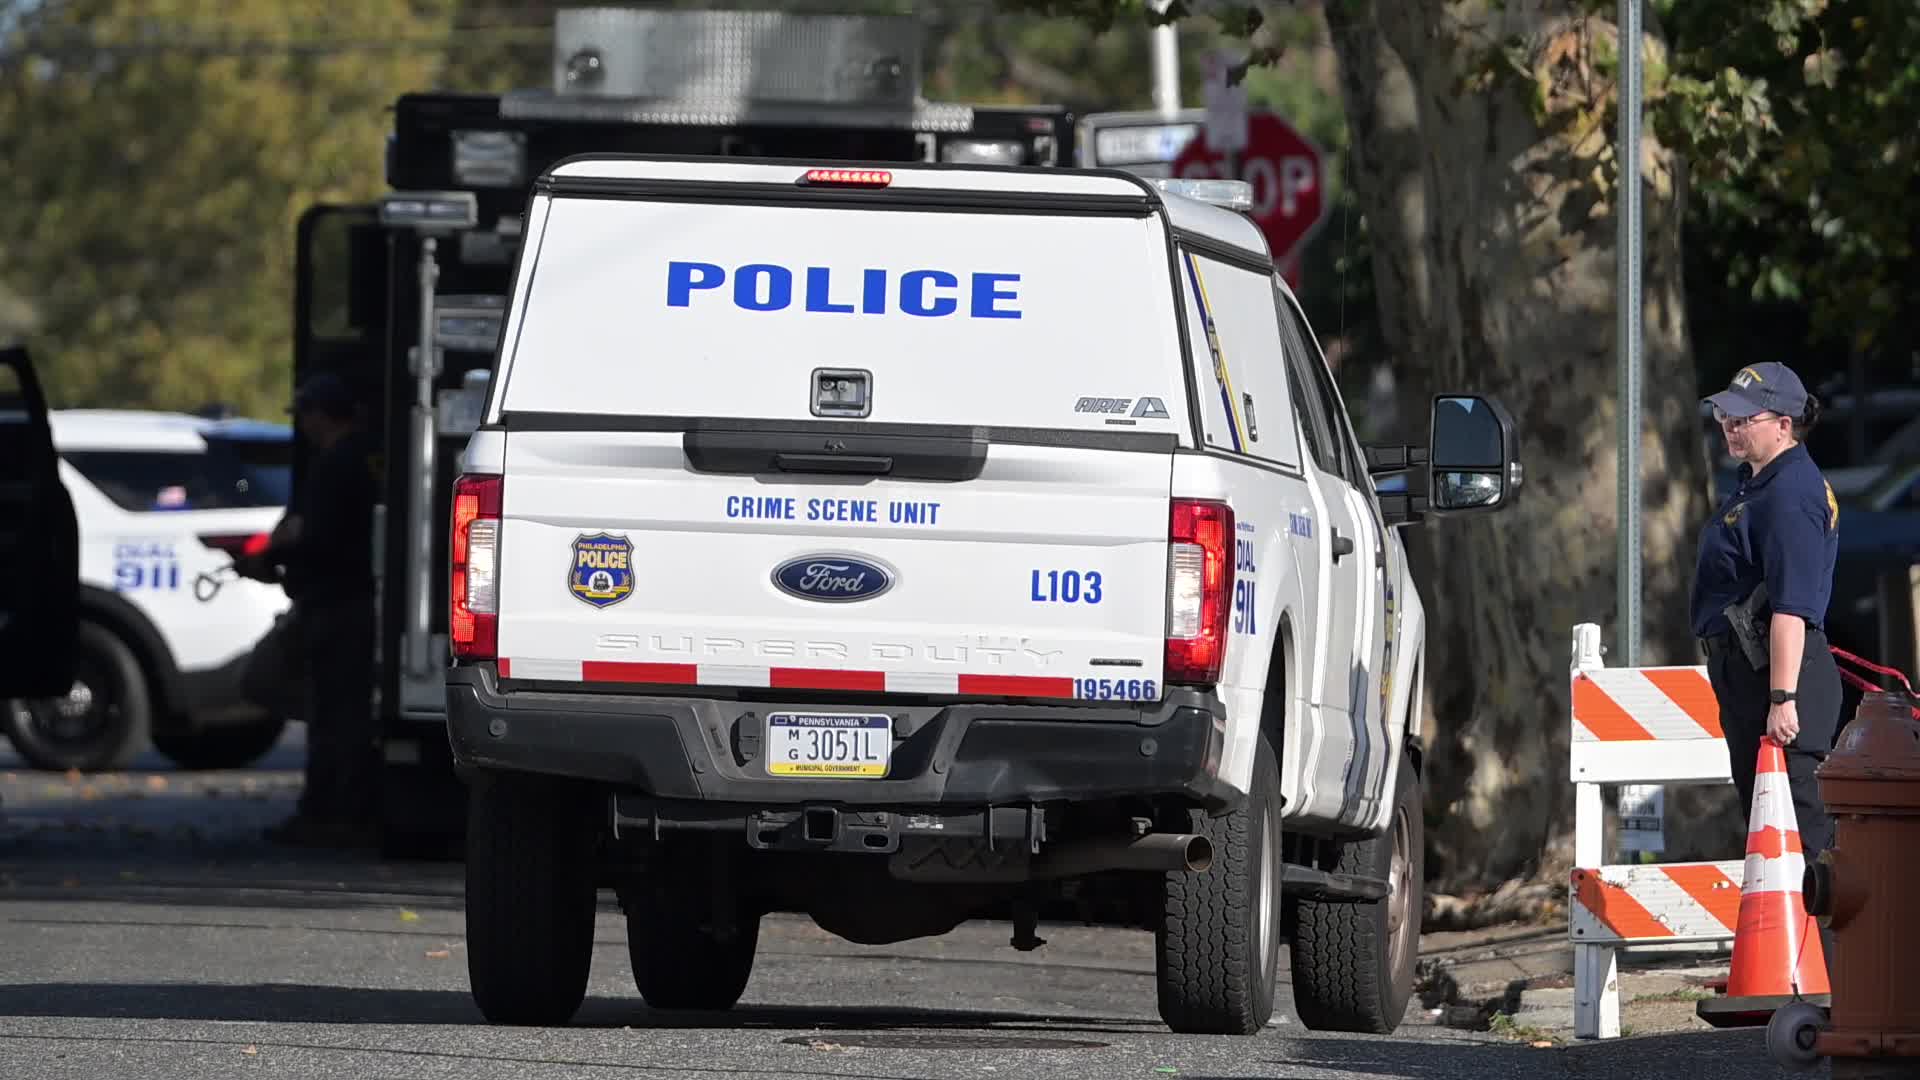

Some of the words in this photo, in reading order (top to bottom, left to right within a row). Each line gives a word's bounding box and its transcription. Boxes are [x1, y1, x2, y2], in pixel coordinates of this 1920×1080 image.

[666, 261, 1022, 319] POLICE
[726, 495, 796, 520] CRIME
[807, 498, 878, 523] SCENE
[889, 501, 941, 525] UNIT
[578, 542, 627, 551] PHILADELPHIA
[578, 550, 627, 569] POLICE
[1236, 538, 1256, 573] DIAL
[114, 561, 179, 592] 911
[799, 563, 866, 592] Ford
[1031, 569, 1103, 604] L103
[1234, 579, 1256, 635] 911
[594, 633, 849, 661] SUPER
[870, 638, 1064, 668] DUTY
[1074, 678, 1157, 701] 195466
[798, 717, 860, 727] PENNSYLVANIA
[806, 729, 878, 762] 3051L
[795, 763, 823, 772] MUNICIPAL
[824, 763, 861, 773] GOVERNMENT
